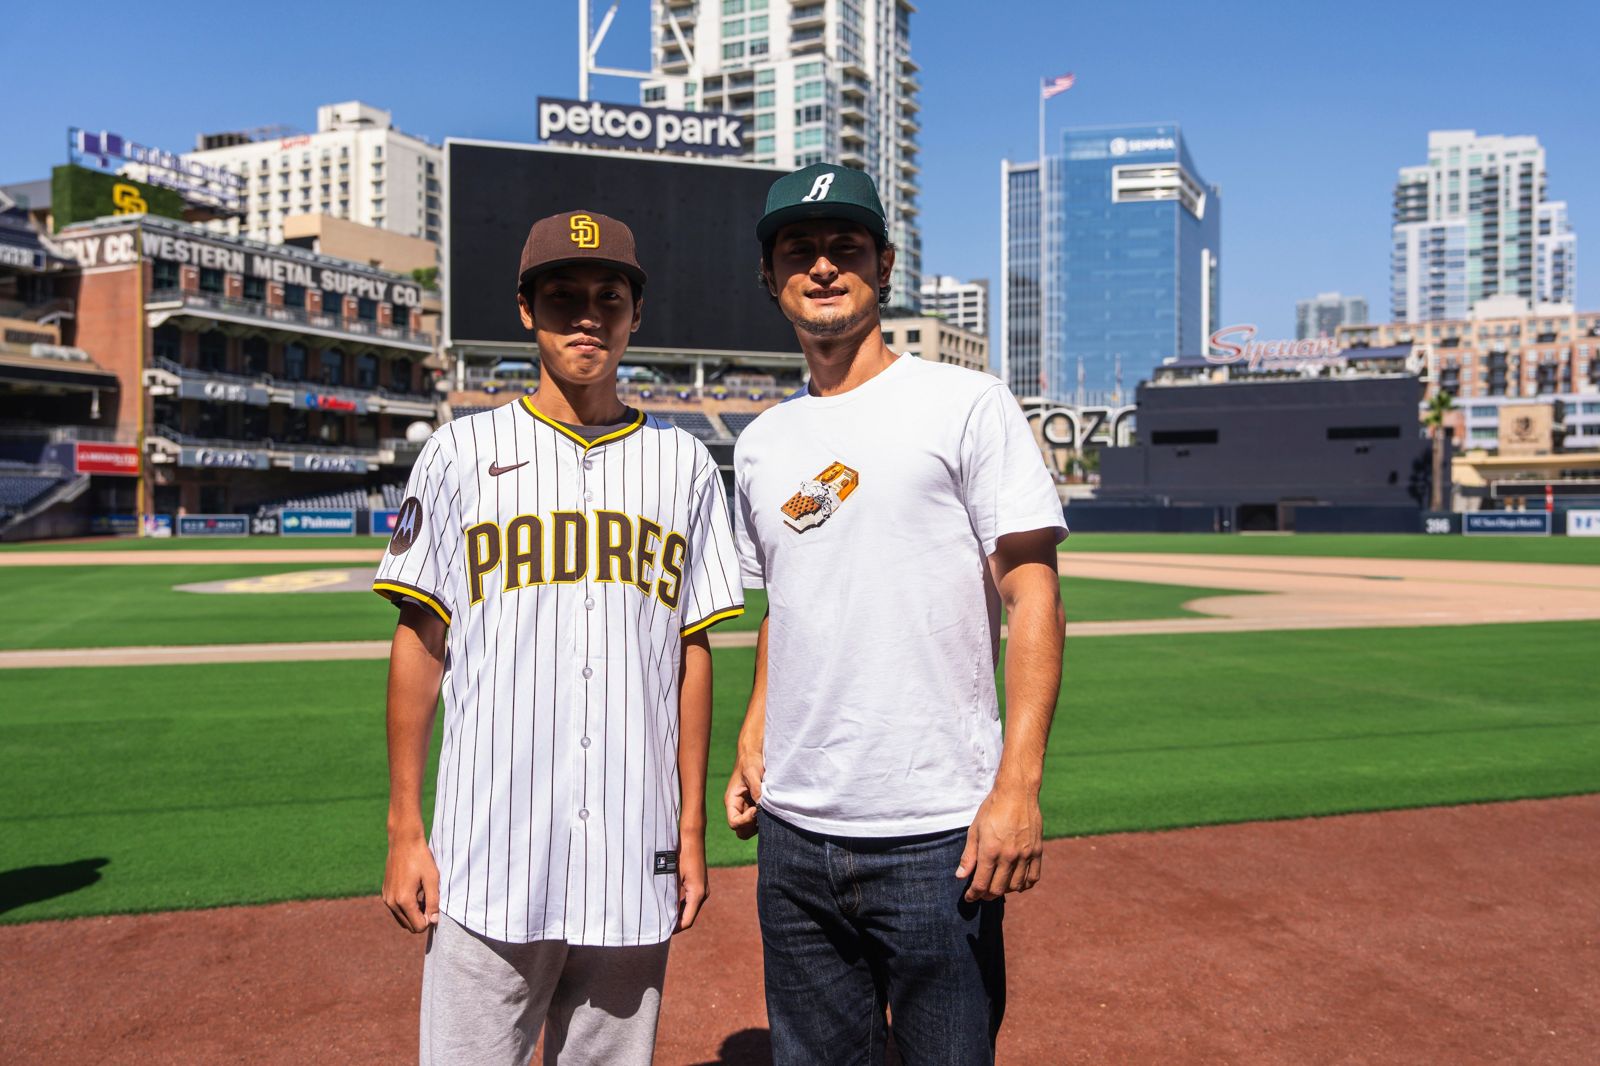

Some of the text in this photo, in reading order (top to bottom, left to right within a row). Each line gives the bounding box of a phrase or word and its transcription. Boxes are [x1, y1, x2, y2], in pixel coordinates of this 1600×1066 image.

[539, 102, 741, 149] petco park
[570, 214, 600, 249] SD
[141, 232, 245, 273] WESTERN
[253, 257, 317, 288] METAL
[321, 270, 386, 301] SUPPLY
[1205, 324, 1343, 370] Sycuan
[301, 515, 352, 529] Palomar
[464, 509, 688, 611] PADRES
